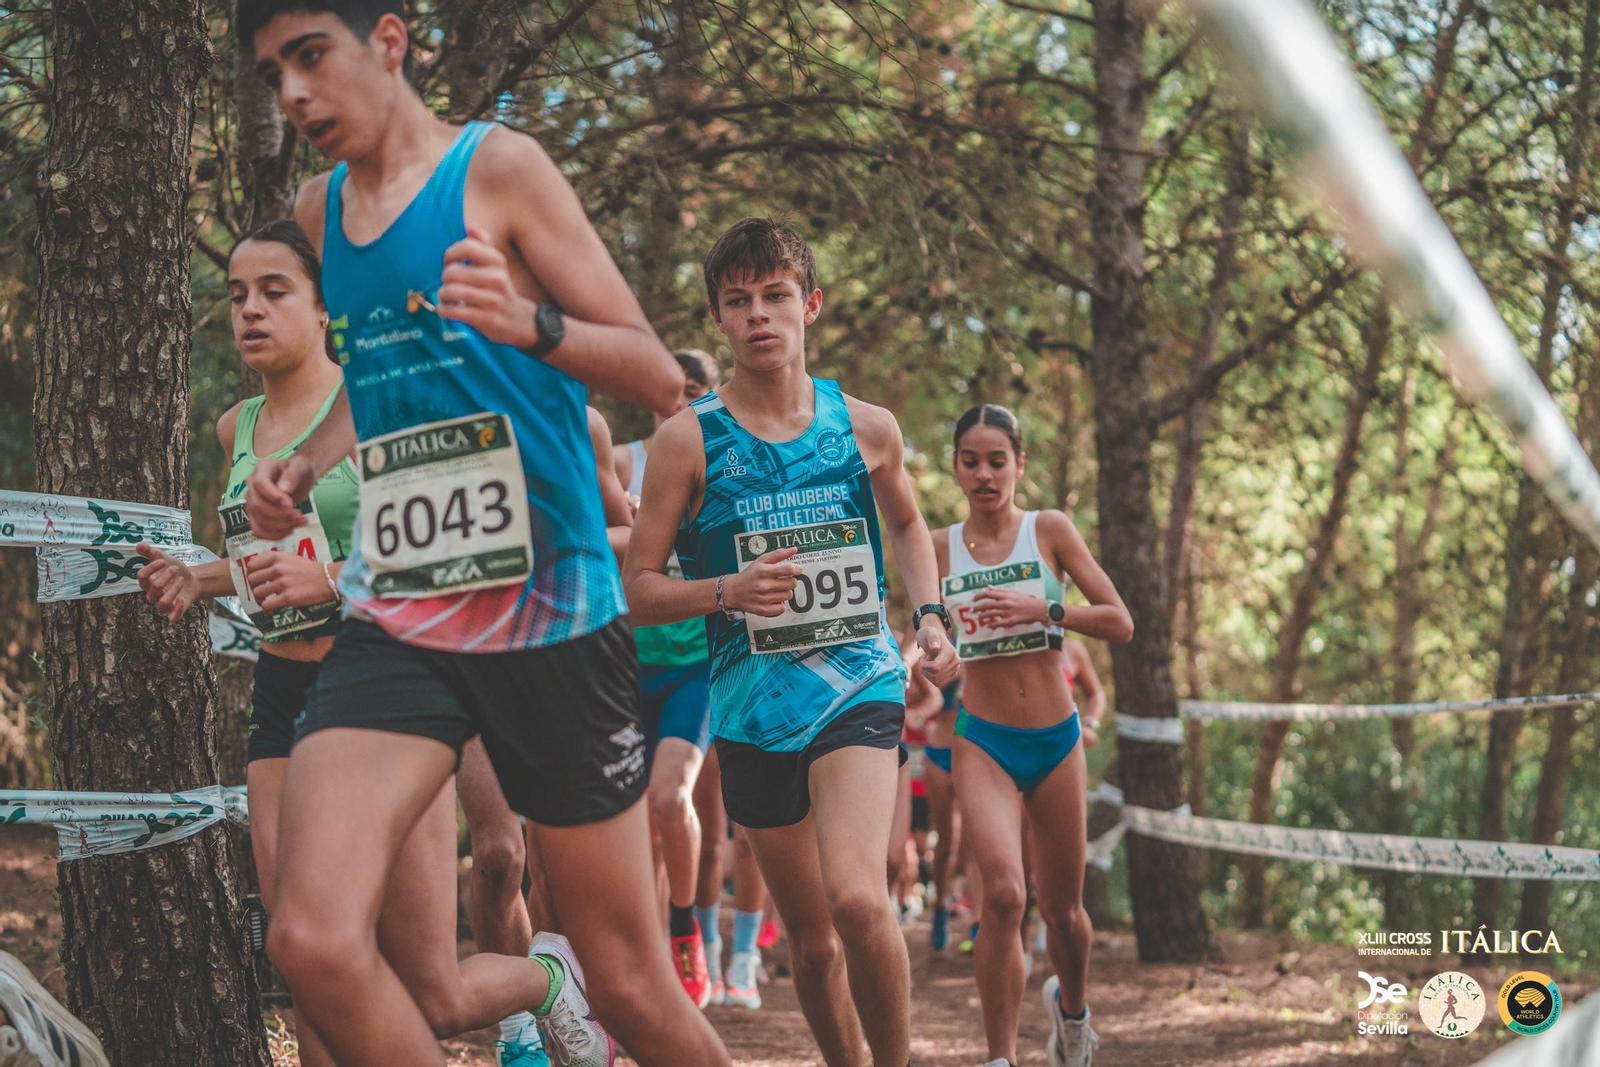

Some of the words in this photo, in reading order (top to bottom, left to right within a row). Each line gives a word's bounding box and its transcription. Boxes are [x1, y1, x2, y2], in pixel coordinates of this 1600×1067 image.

[723, 465, 747, 478] BY2
[736, 495, 773, 516] CLUB
[776, 485, 849, 509] ONUBENSE
[376, 481, 513, 557] 6043
[745, 515, 765, 533] DE
[767, 504, 845, 529] ATLETISMO
[775, 528, 837, 548] ITÁLICA
[788, 565, 870, 614] 095
